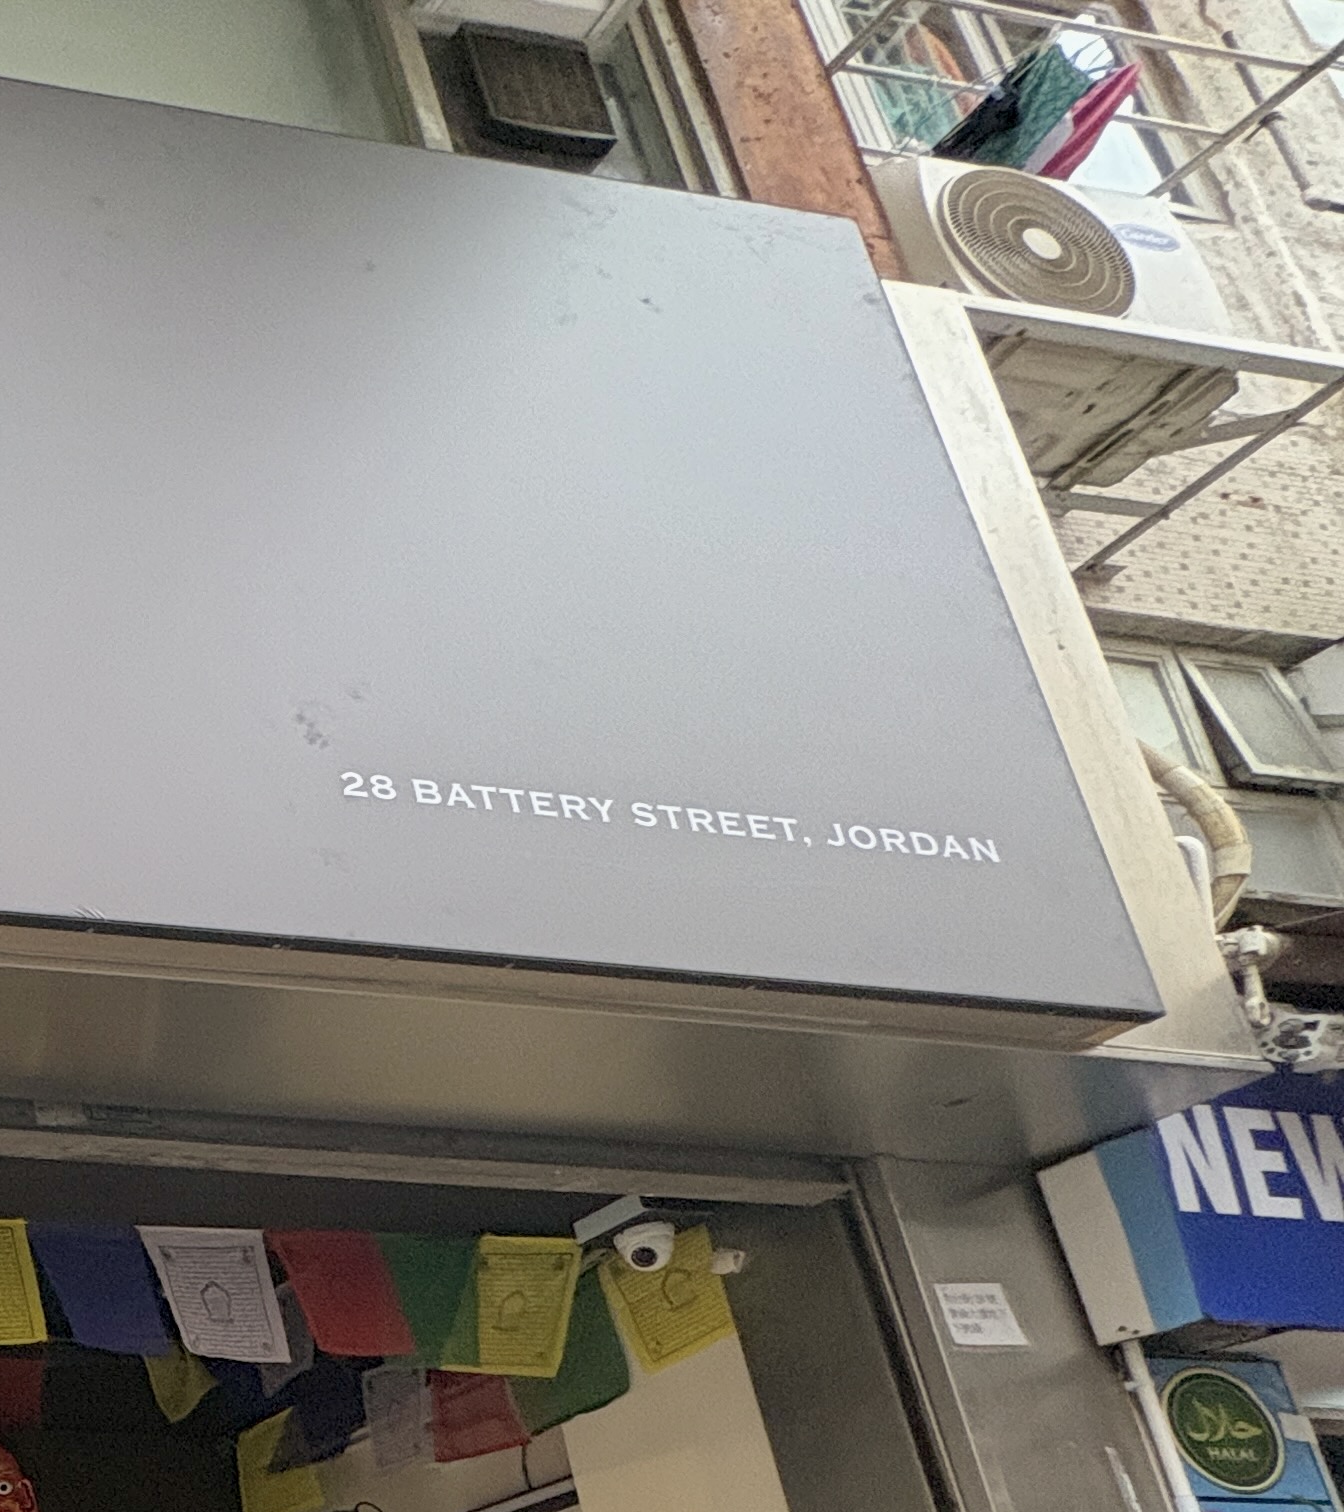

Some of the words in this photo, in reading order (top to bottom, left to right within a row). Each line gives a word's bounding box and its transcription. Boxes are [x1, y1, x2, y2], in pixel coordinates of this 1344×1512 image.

[339, 771, 398, 801] 28
[411, 778, 614, 824] BATTERY
[631, 800, 814, 848] STREET,
[826, 821, 1002, 864] JORDAN
[1206, 1446, 1260, 1462] HALAL
